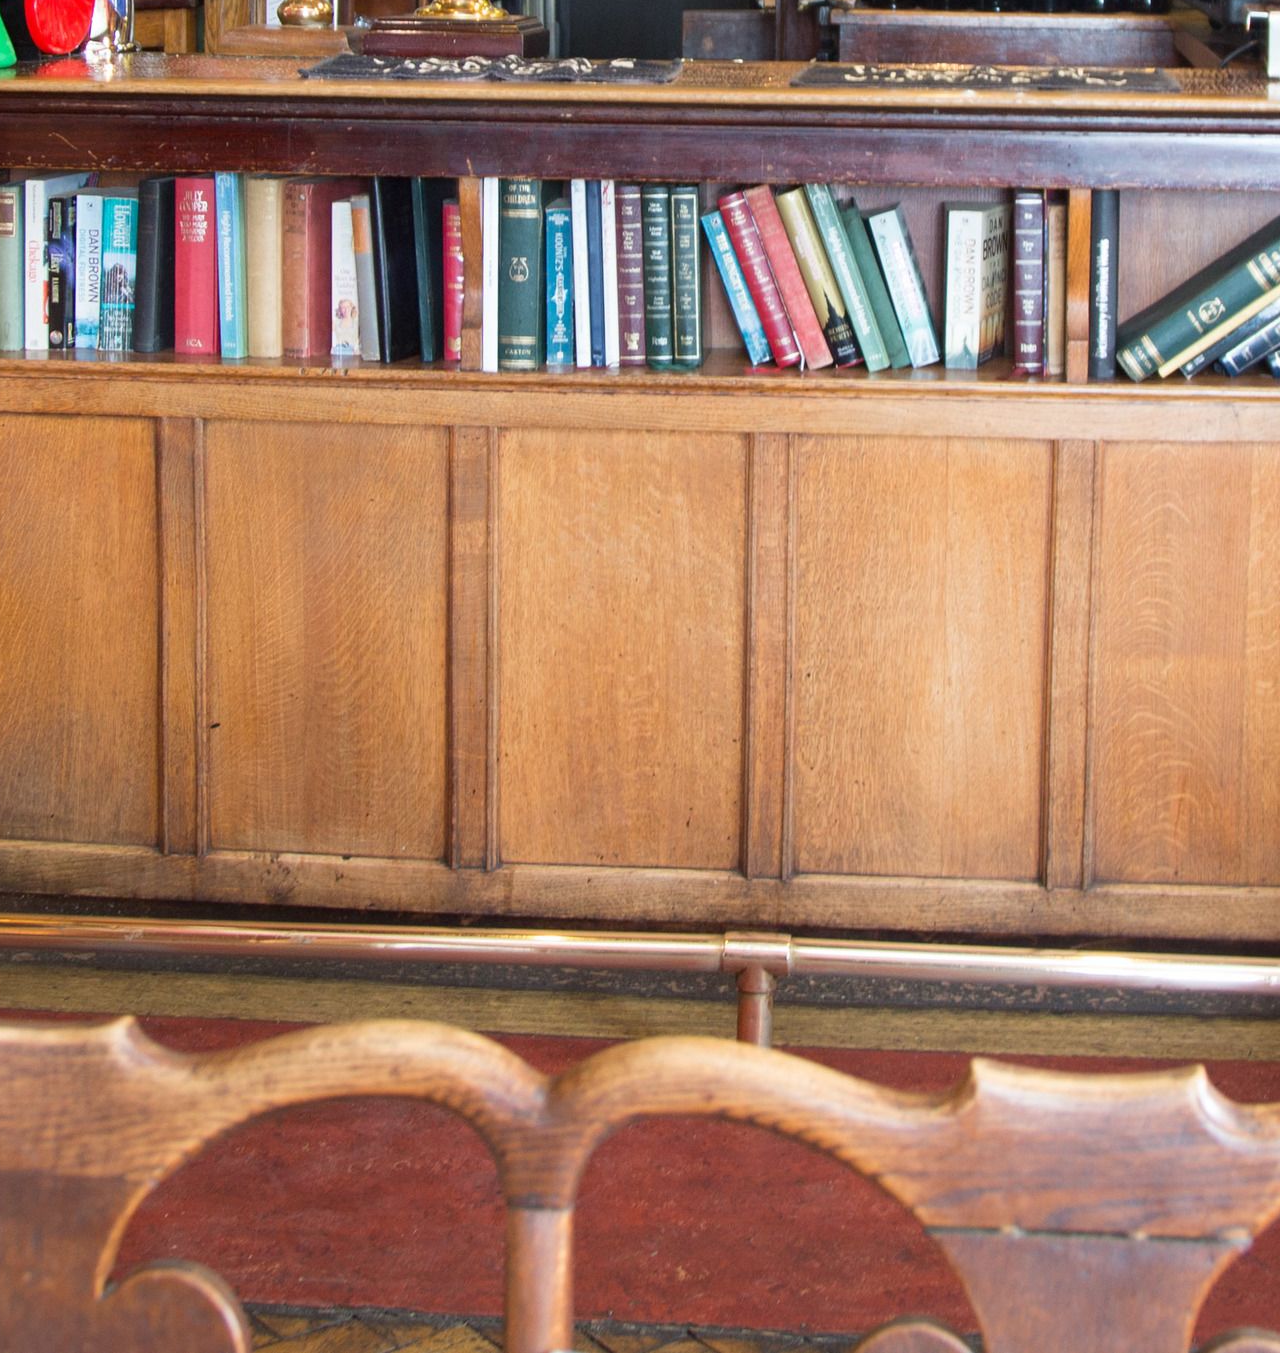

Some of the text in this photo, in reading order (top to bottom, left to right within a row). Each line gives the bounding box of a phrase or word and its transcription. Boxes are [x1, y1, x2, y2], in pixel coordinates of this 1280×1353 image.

[504, 194, 536, 204] CHILDREN
[519, 184, 531, 193] THE
[112, 203, 131, 249] Howard
[989, 217, 1003, 233] DAN
[79, 229, 87, 259] DIGITAL
[983, 234, 1009, 261] BROWN
[87, 229, 100, 304] DAN BROWN
[221, 210, 233, 321] Highly Recommended Hotels
[964, 239, 976, 314] DAN BROWN
[835, 250, 862, 310] Recommended
[854, 308, 871, 336] Hotels
[985, 290, 1002, 309] CODE
